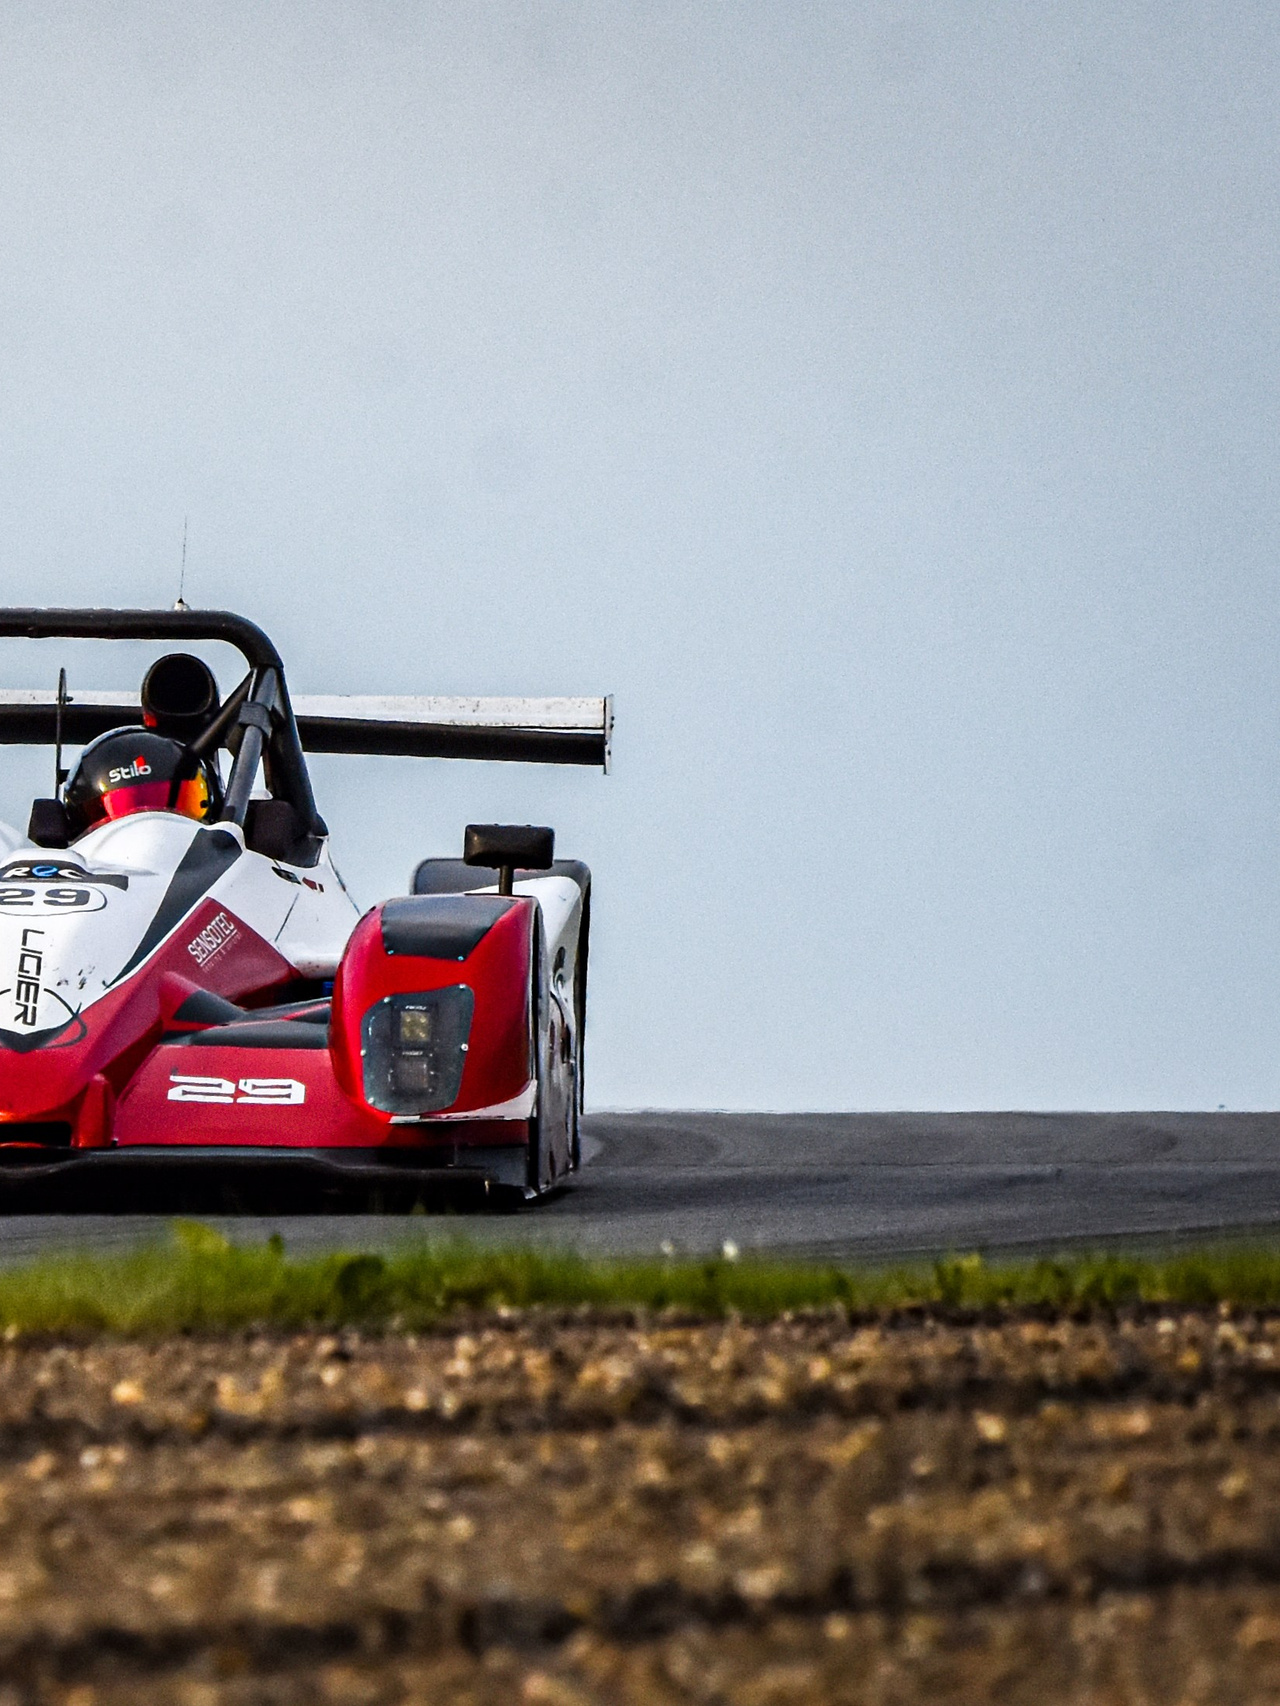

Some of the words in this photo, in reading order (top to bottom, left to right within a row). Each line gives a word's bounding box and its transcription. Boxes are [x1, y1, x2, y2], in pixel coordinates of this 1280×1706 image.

[187, 911, 235, 964] SENSOTEC
[13, 928, 45, 1027] LIGIER
[167, 1074, 306, 1105] 29
